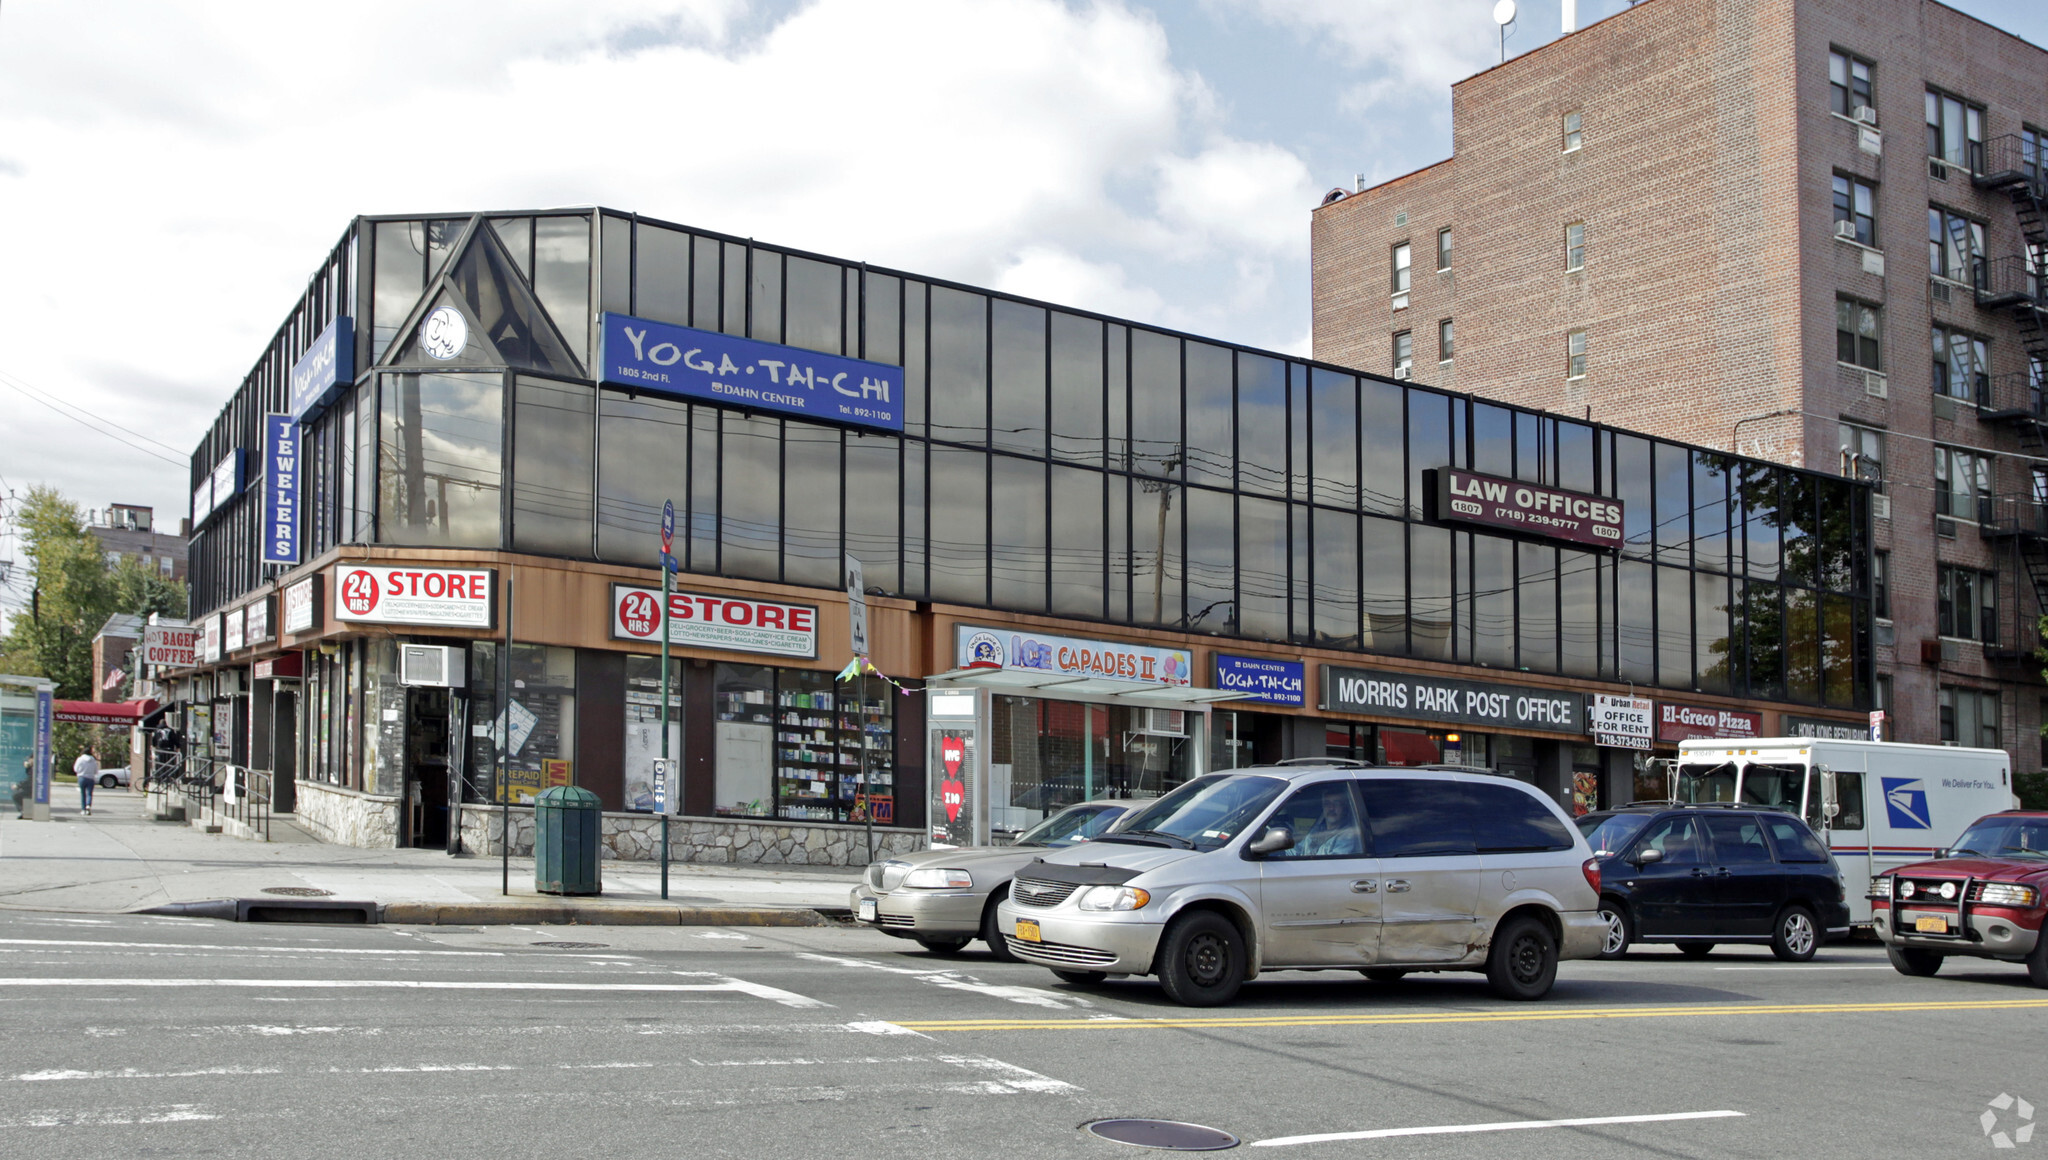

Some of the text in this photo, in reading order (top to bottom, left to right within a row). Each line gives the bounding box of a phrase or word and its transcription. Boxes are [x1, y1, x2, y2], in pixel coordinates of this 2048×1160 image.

[618, 366, 671, 383] 1805 2nd Fl.
[724, 385, 805, 408] DAHN CENTER
[839, 404, 892, 421] Tel. 892-1100
[276, 422, 294, 556] JEWELERS
[1450, 475, 1621, 524] LAW OFFICES
[1454, 502, 1479, 514] 1807
[1495, 508, 1579, 530] (718) 239-6777
[1594, 527, 1618, 538] 1807
[347, 573, 372, 598] 24
[387, 571, 486, 599] STORE
[350, 599, 370, 611] HRS
[626, 595, 652, 620] 24
[669, 594, 812, 632] STORE
[628, 619, 650, 633] HRS
[685, 624, 714, 632] GROCERY
[753, 631, 773, 639] CANDY
[787, 635, 807, 643] CREAM
[146, 631, 162, 644] HOT
[692, 632, 732, 641] NEWSPAPERS
[770, 640, 807, 650] CIGARETTES
[150, 647, 194, 664] COFFEE
[1010, 635, 1155, 679] ICE CAPADES II
[1261, 664, 1285, 672] CENTER
[1274, 693, 1301, 702] 892-1100
[1339, 677, 1407, 708] MORRIS
[1415, 685, 1459, 713] PARK
[1466, 691, 1510, 718] POST
[1516, 696, 1571, 724] OFFICE
[1611, 698, 1650, 710] Urban Retail
[56, 713, 77, 721] SONS
[77, 715, 110, 723] FUNERAL
[1604, 711, 1644, 723] OFFICE
[1663, 705, 1751, 731] El-Greco Pizza
[1597, 721, 1649, 734] FOR RENT
[1799, 722, 1868, 741] HONG KONG RESTAURANT
[1601, 734, 1650, 748] 718-373-0333
[944, 749, 960, 761] NYC
[500, 769, 540, 780] PREPAID
[549, 762, 566, 786] TM
[1942, 778, 1951, 787] We
[1952, 778, 1972, 788] Deliver
[1973, 780, 1982, 789] For
[945, 792, 950, 804] I
